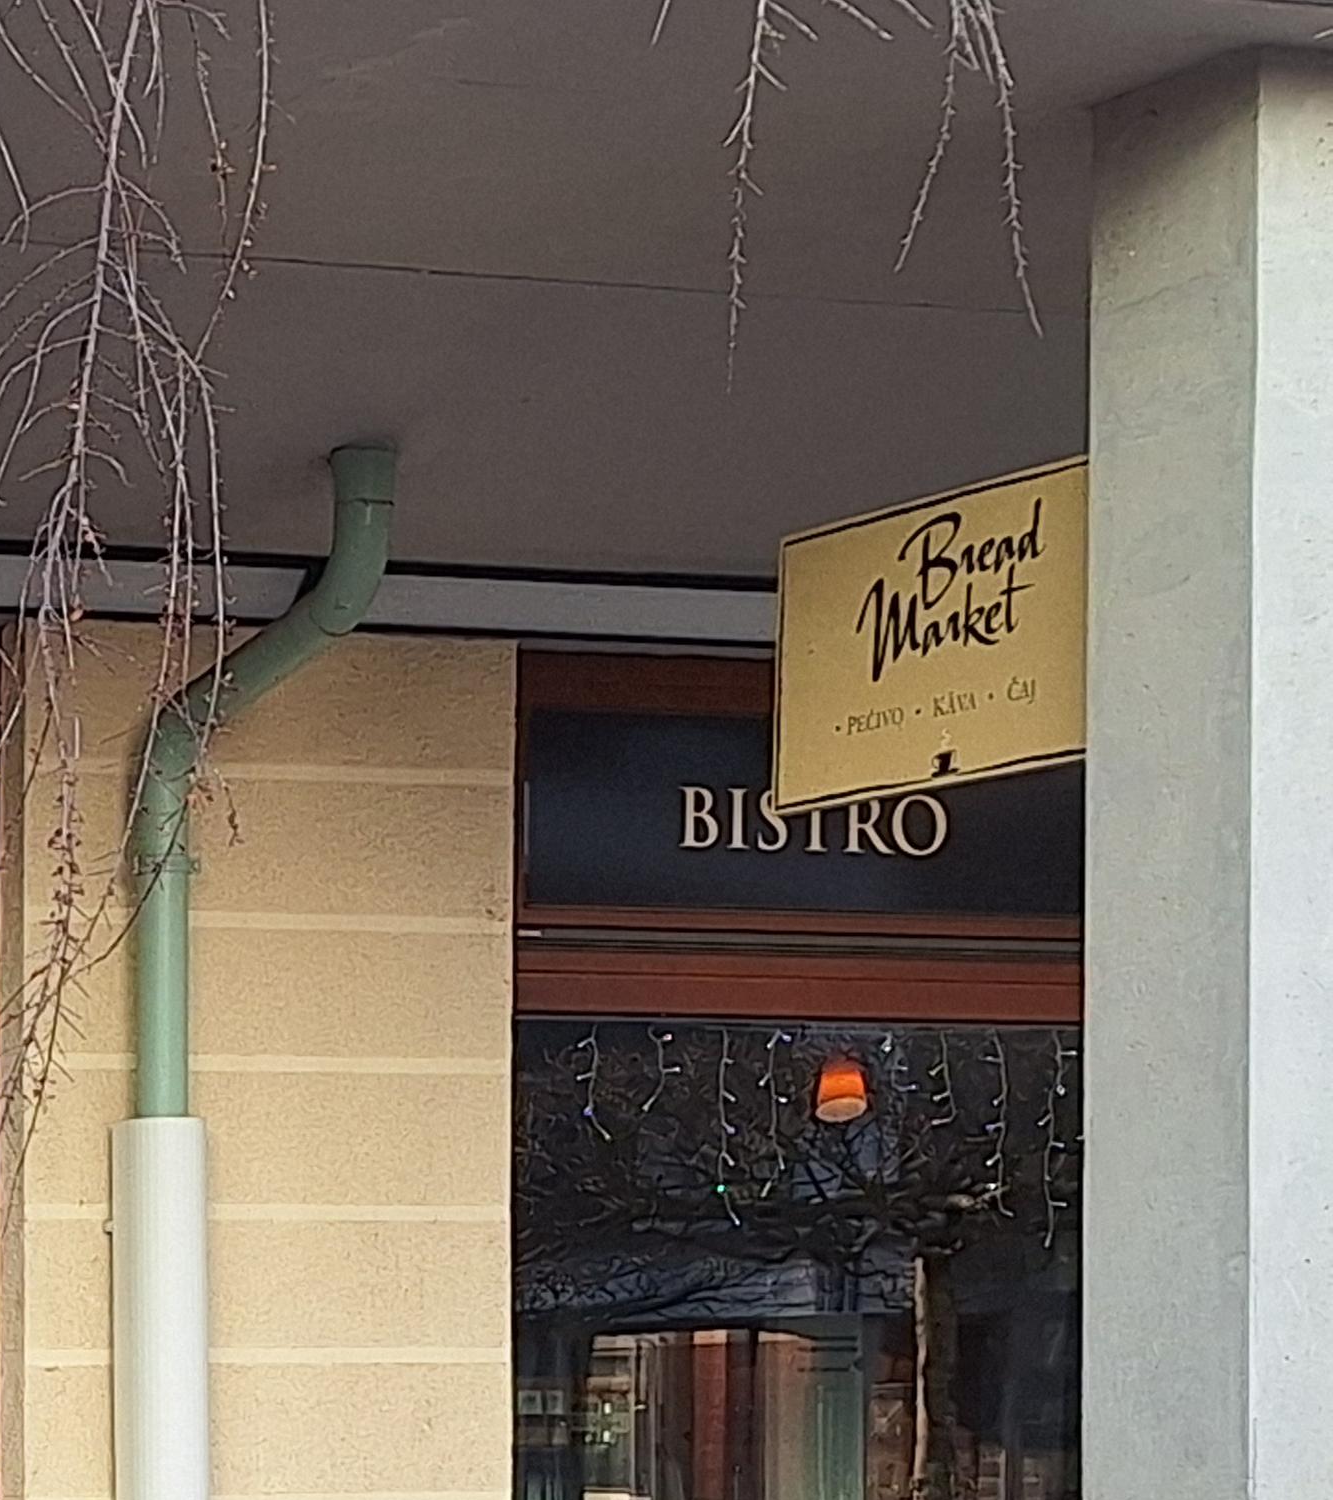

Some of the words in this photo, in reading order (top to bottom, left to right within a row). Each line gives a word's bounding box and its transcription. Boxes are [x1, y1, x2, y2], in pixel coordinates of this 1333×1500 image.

[898, 498, 1047, 608] Bread
[855, 566, 1035, 683] Market
[845, 704, 905, 737] PEČIVO
[932, 689, 978, 719] KÁVA
[1006, 675, 1037, 705] ČAJ
